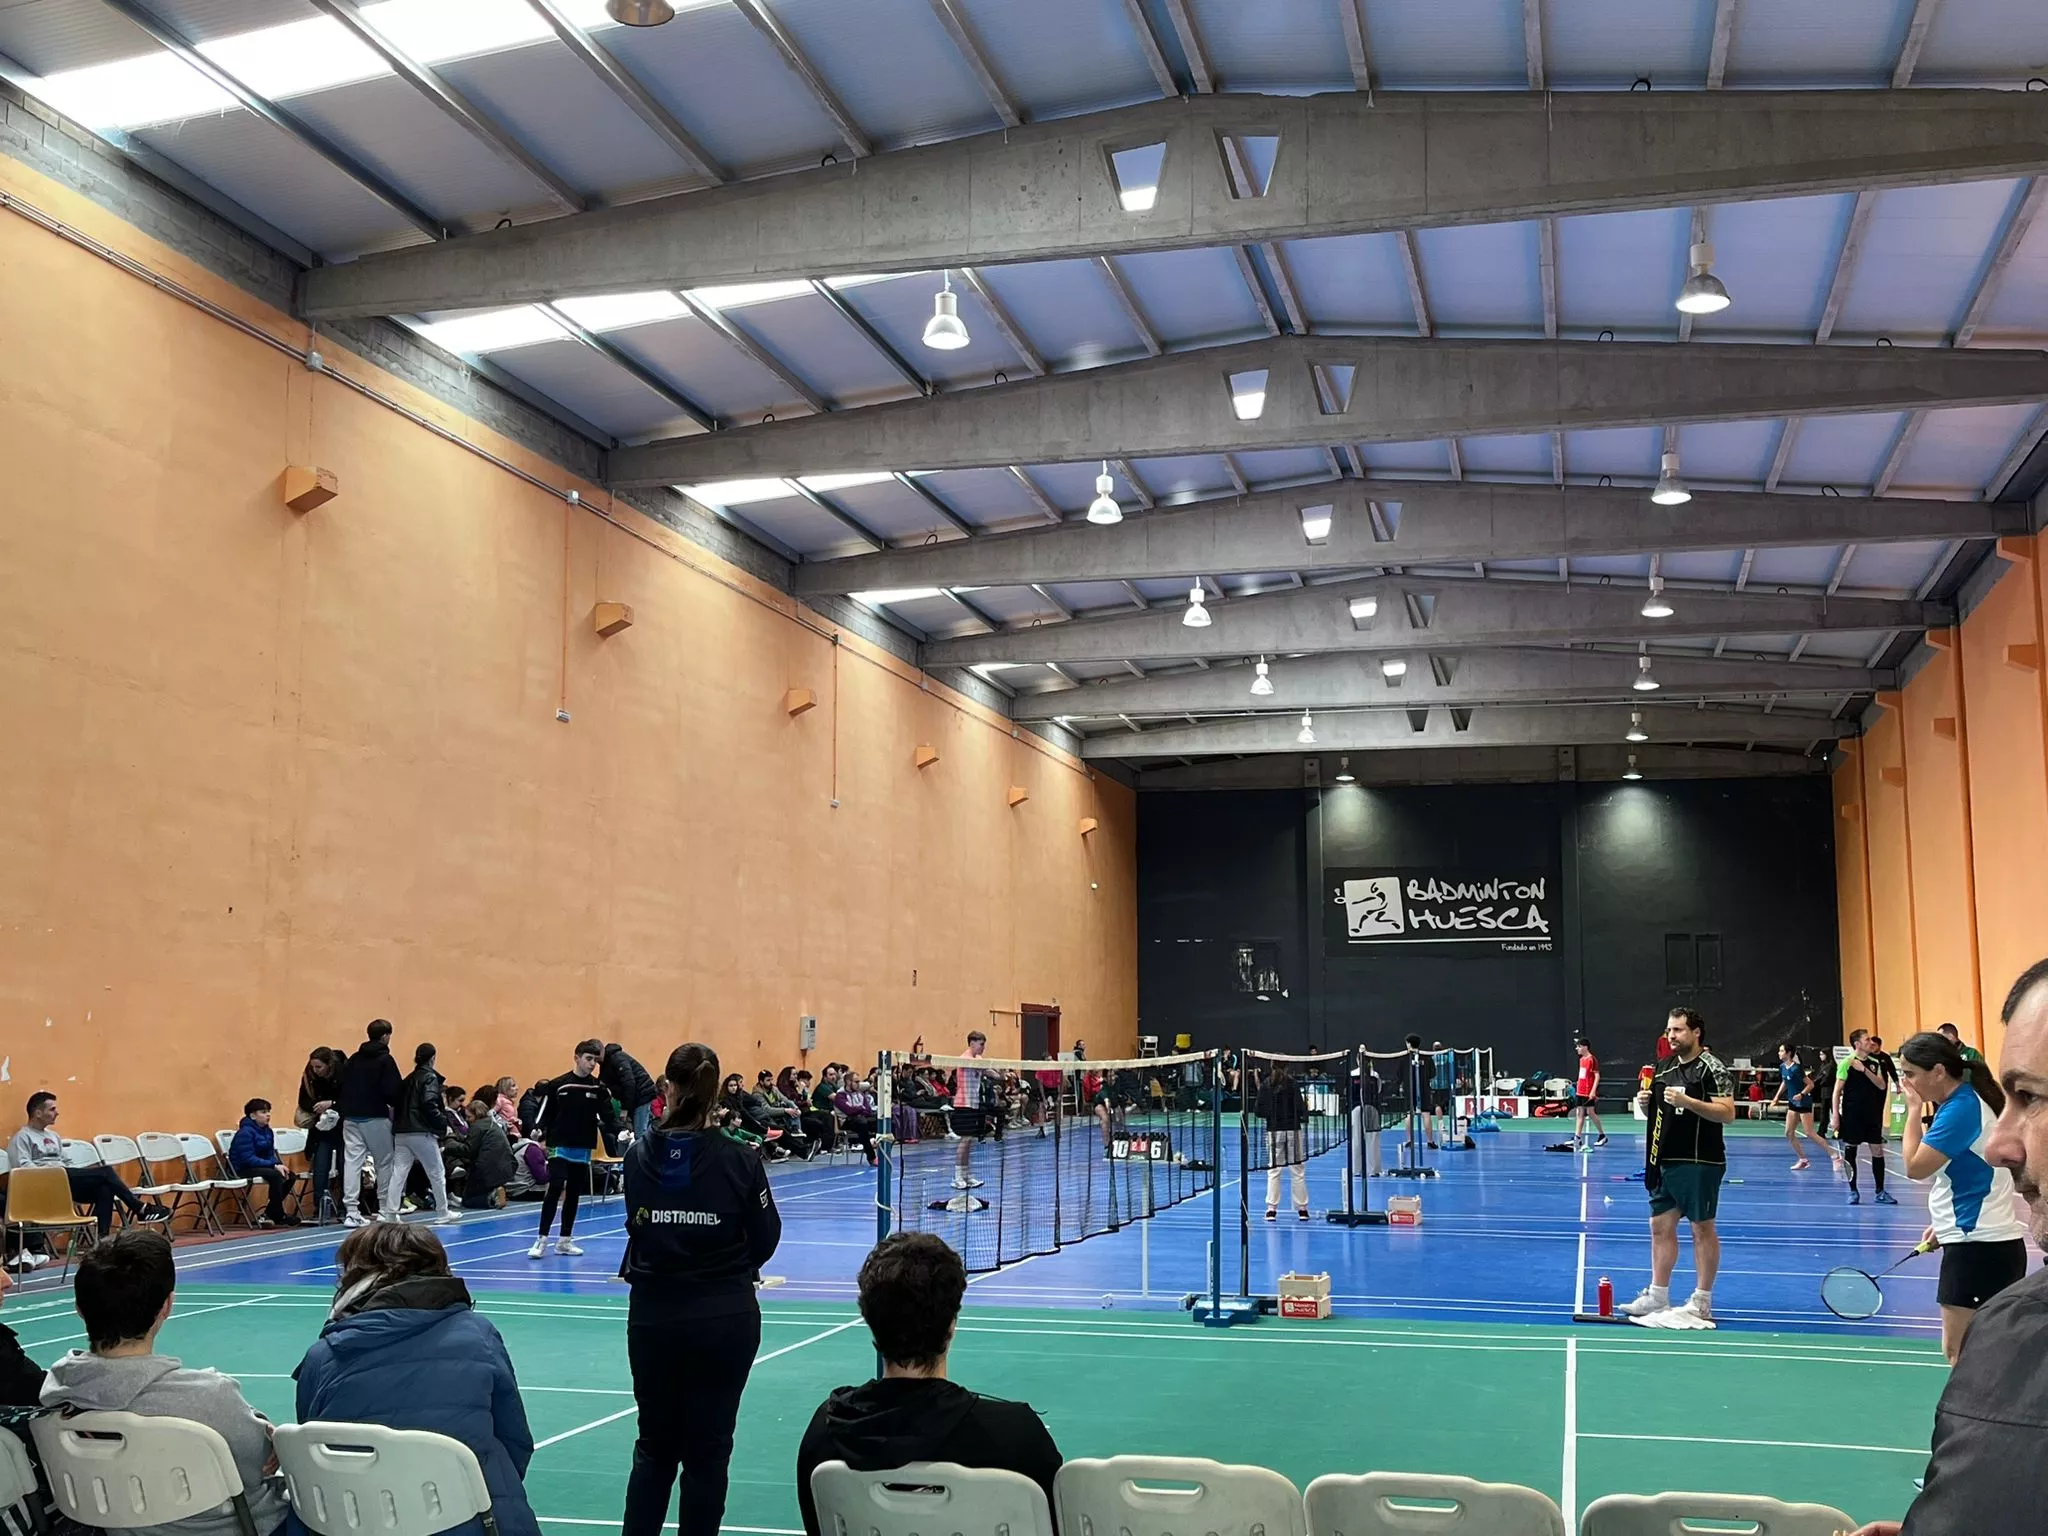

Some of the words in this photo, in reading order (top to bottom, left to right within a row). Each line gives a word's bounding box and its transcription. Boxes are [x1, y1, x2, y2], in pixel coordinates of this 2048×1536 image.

[1408, 904, 1550, 934] HUESCA
[1112, 1139, 1129, 1158] 10
[1150, 1140, 1162, 1159] 6
[1649, 1107, 1664, 1166] carlton
[651, 1209, 721, 1226] DISTROMEL
